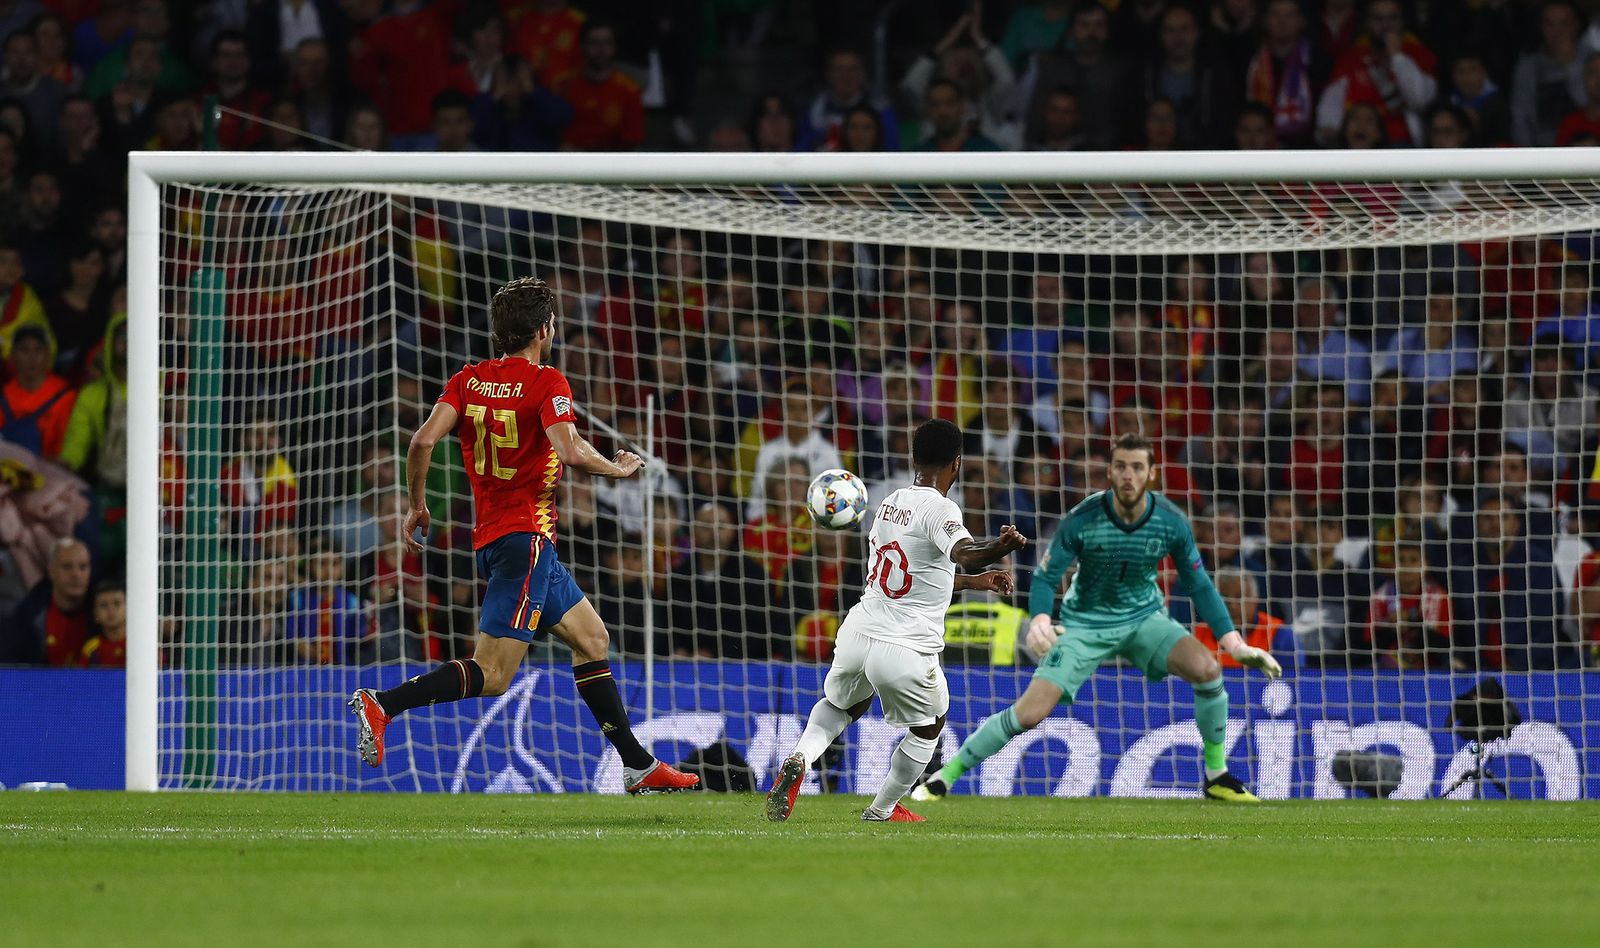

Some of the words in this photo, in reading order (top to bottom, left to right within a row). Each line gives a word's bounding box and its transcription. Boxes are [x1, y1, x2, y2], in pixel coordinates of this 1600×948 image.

[466, 376, 511, 398] MARCOS
[511, 382, 524, 398] A.
[464, 403, 519, 480] 12
